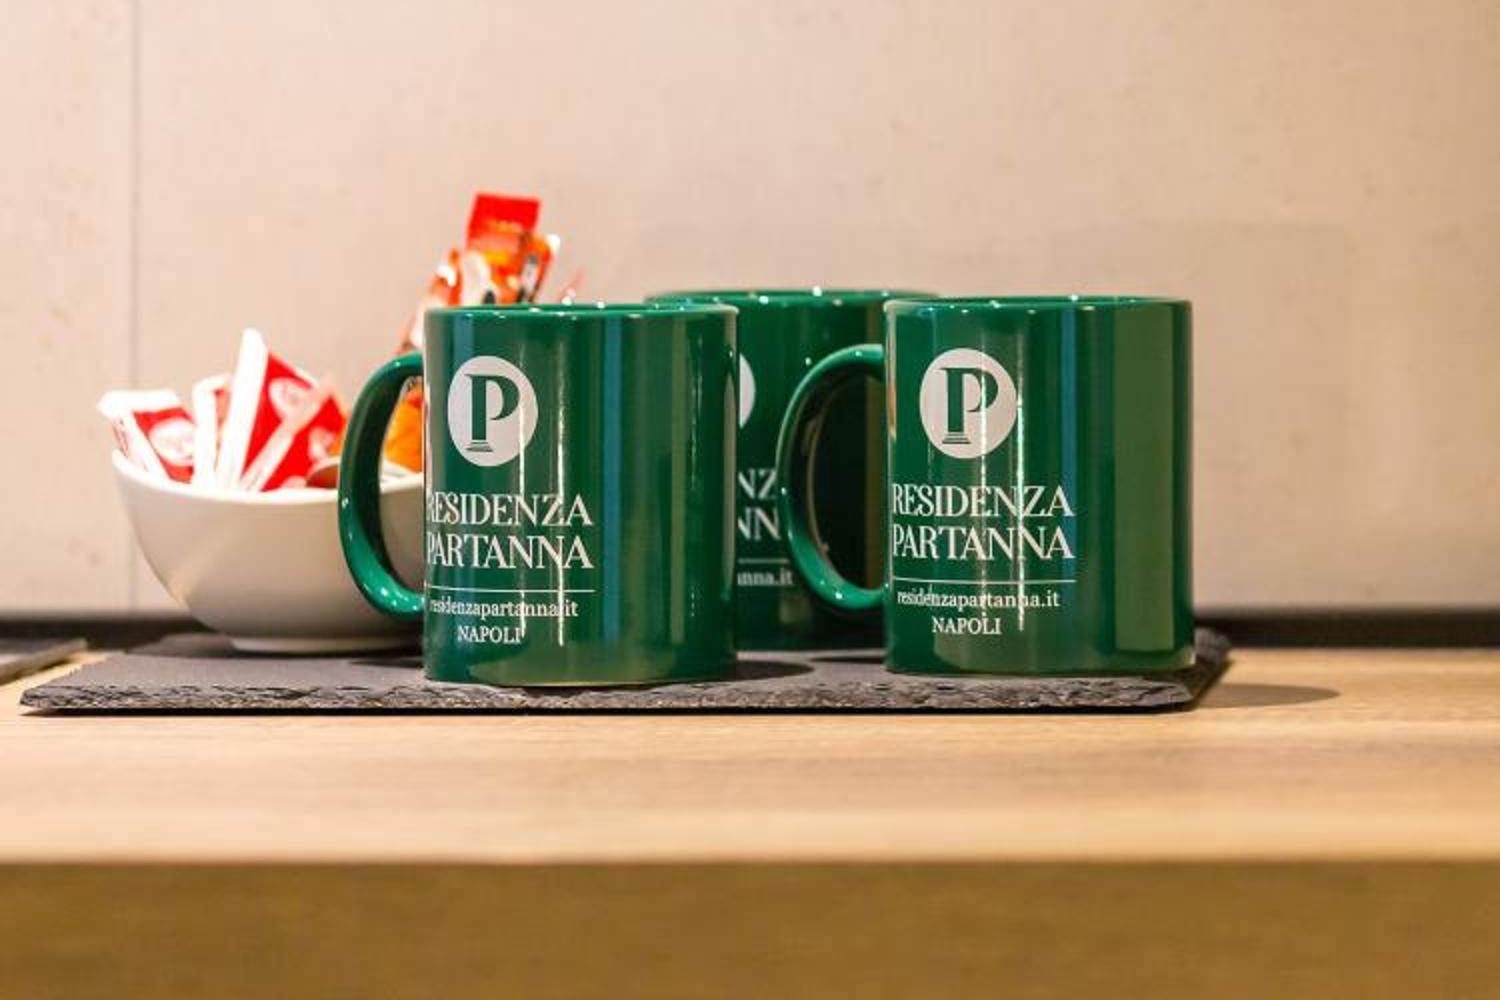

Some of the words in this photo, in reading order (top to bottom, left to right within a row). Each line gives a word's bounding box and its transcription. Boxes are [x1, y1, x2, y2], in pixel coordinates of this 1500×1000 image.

[891, 483, 1075, 517] RESIDENZA
[427, 533, 595, 569] PARTANNA
[892, 525, 1076, 560] PARTANNA
[430, 594, 579, 620] residenzapartannait
[897, 589, 1060, 615] residenzapartanna.it
[457, 625, 523, 645] NAPOLI
[932, 617, 1001, 635] NAPOLI
